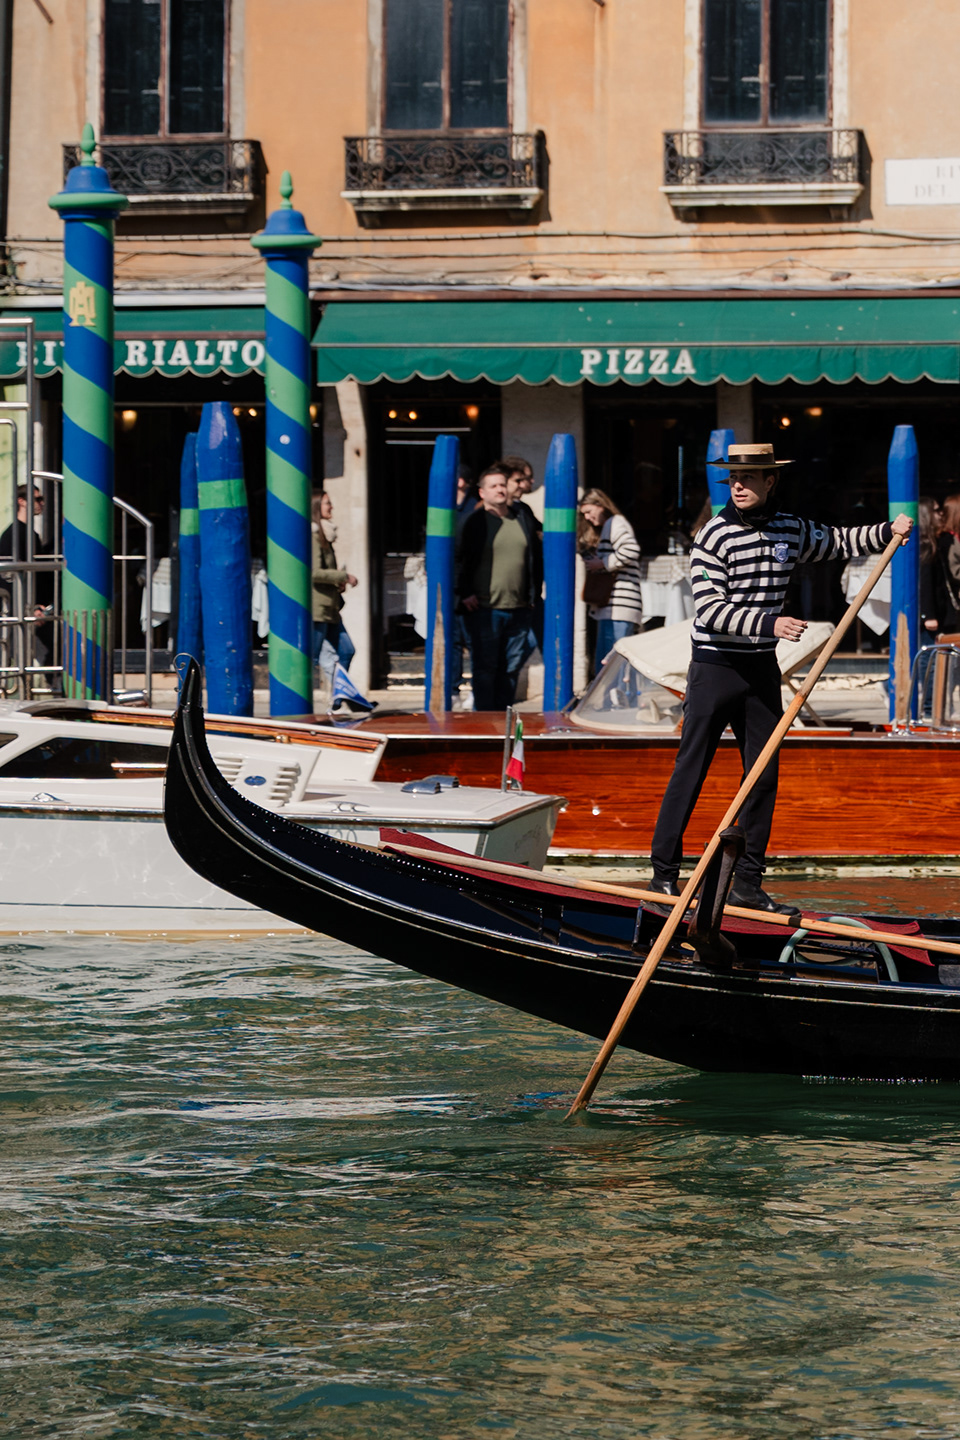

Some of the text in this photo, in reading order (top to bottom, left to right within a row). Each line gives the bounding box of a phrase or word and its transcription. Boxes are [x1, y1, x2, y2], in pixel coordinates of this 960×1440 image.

[914, 183, 951, 198] DEL
[124, 340, 266, 367] RIALTO
[580, 349, 697, 375] PIZZA
